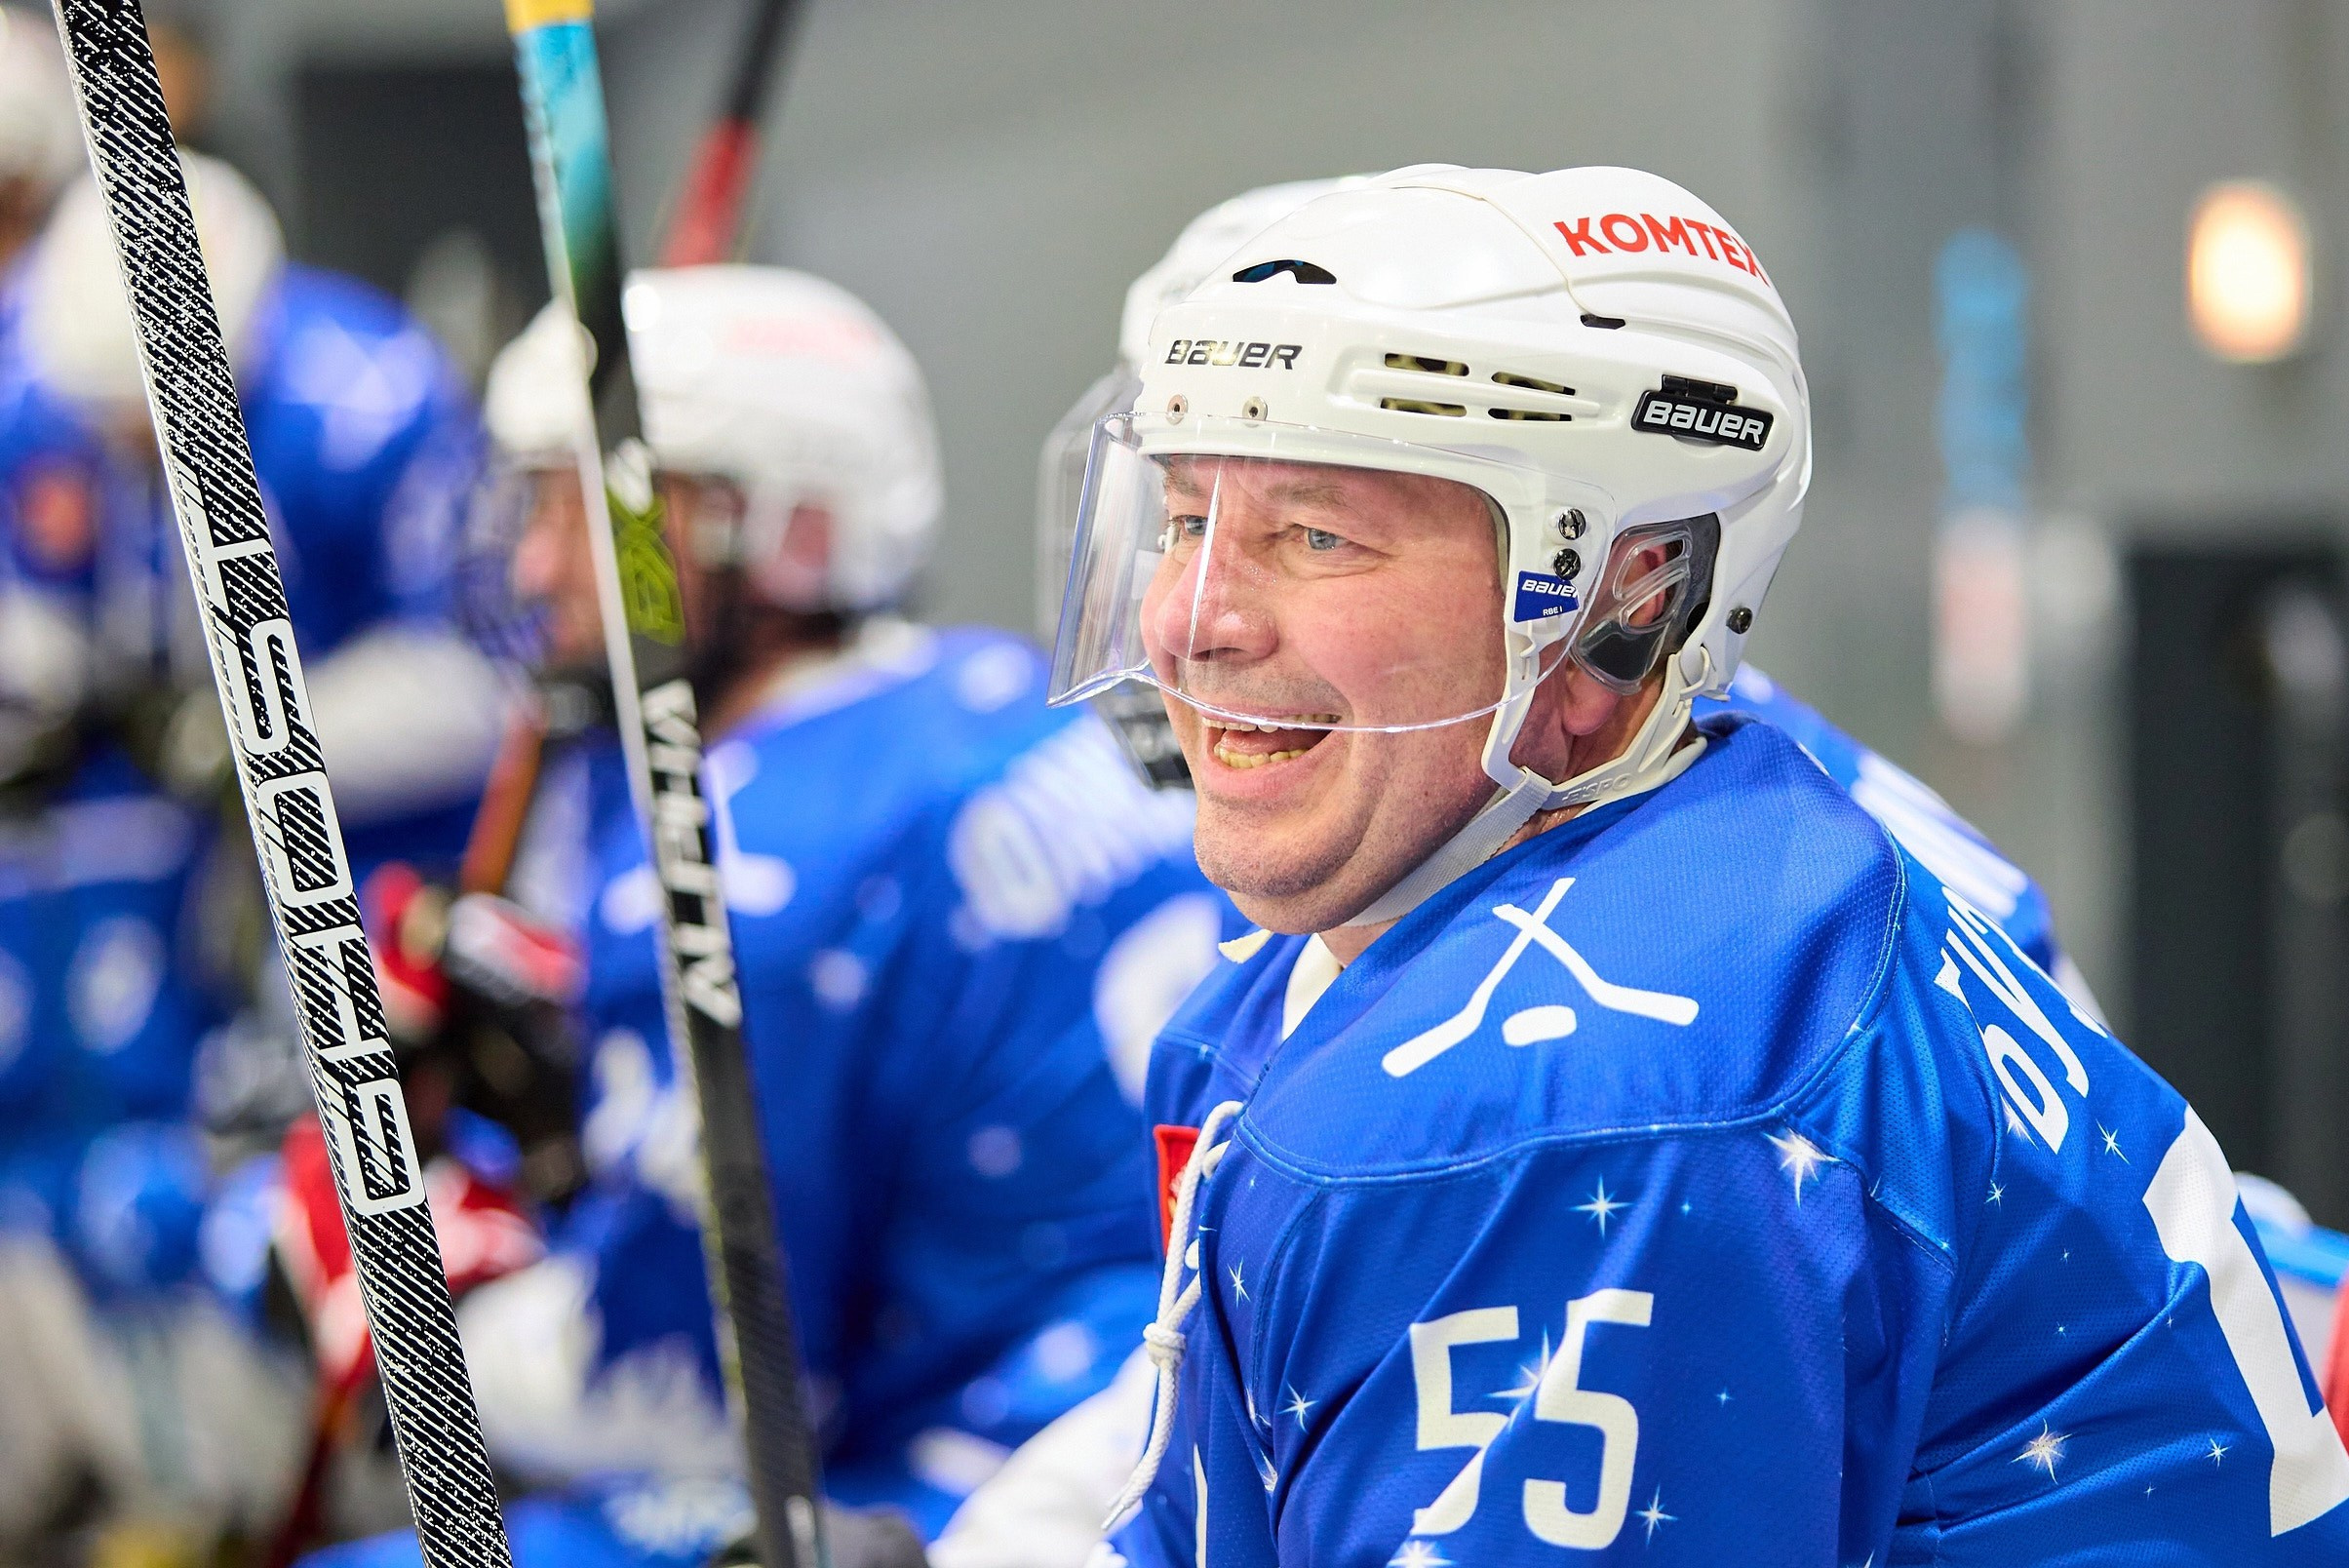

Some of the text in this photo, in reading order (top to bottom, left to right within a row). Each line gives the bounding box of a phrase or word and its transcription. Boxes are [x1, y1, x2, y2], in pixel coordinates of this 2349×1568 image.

[1553, 213, 1771, 289] KOMTEX
[1164, 339, 1303, 370] BAUER
[1642, 400, 1765, 445] BAUER
[177, 464, 425, 1216] GHOST
[1409, 1288, 1655, 1550] 55
